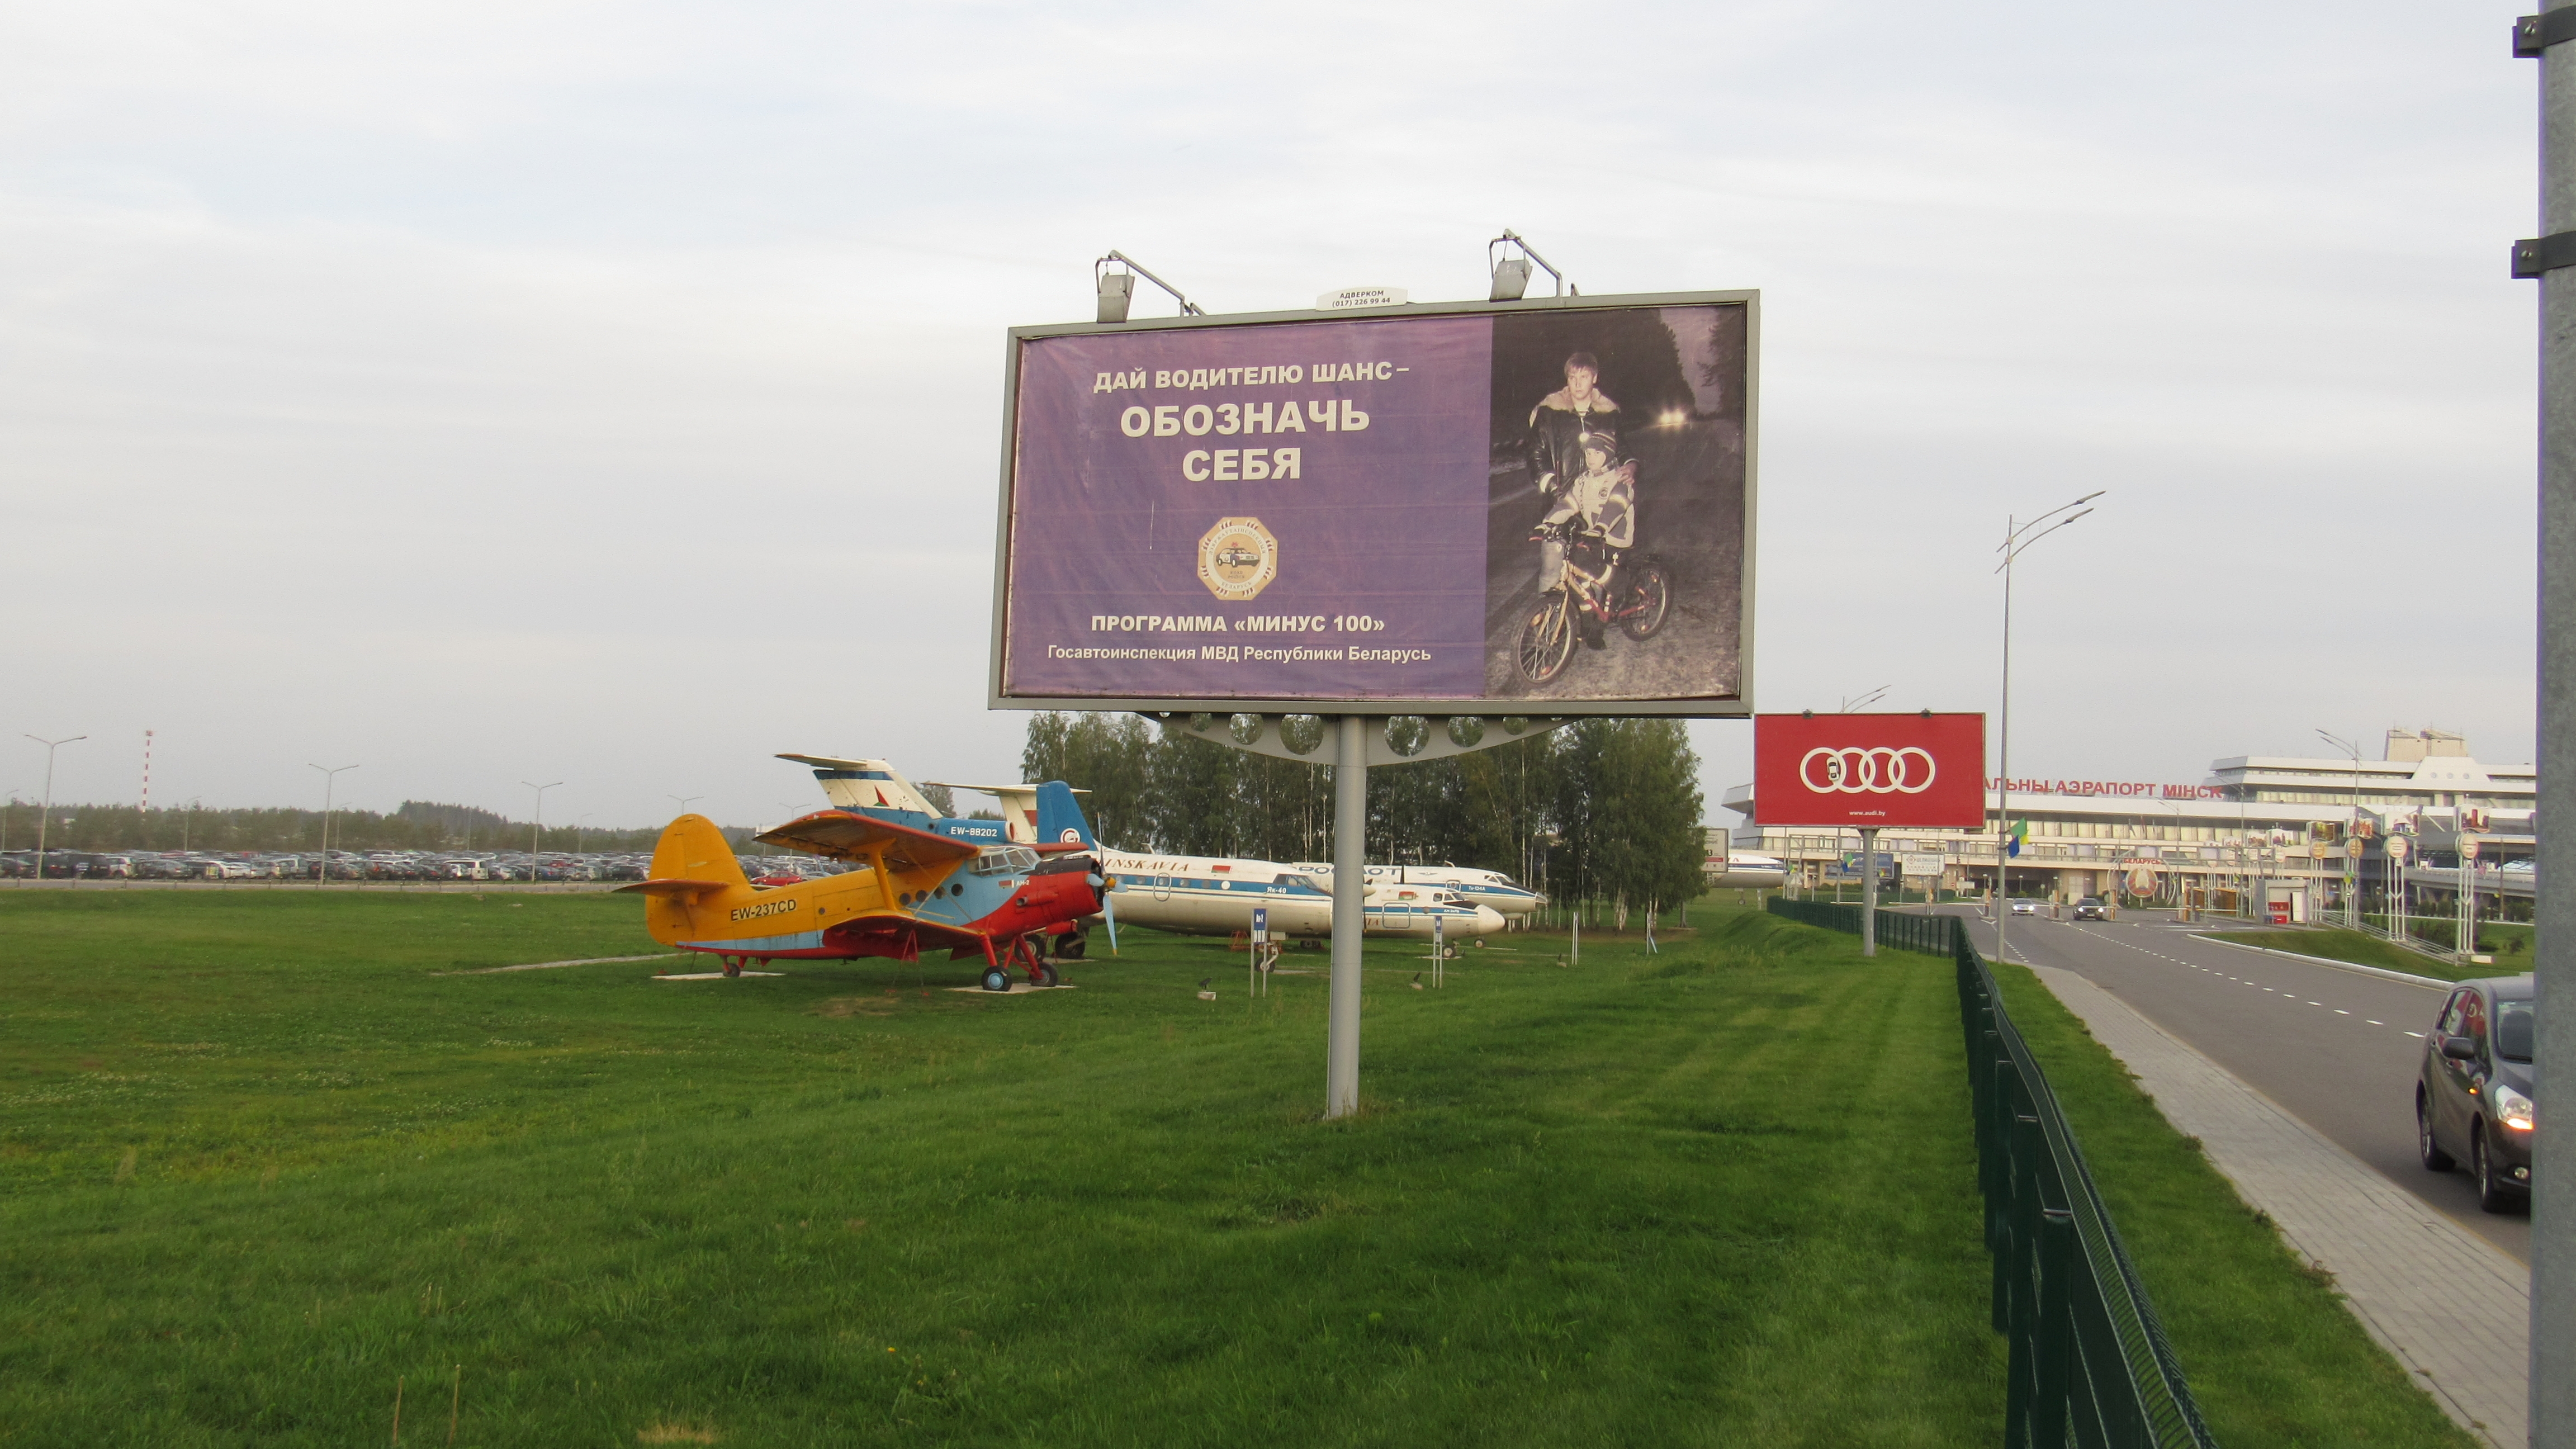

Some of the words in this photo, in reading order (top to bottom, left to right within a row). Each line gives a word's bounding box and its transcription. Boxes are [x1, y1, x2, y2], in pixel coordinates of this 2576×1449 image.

[1339, 290, 1384, 299] АДВЕРКОМ
[1332, 300, 1352, 308] (017)
[1093, 367, 1147, 394] ДАЙ
[1155, 364, 1303, 391] ВОДИТЕЛЮ
[1121, 399, 1370, 437] ОБОЗНАЧЬ
[1182, 447, 1301, 482] СЕБЯ
[1091, 615, 1228, 632] ПРОГРАММА
[1234, 615, 1325, 632] «МИНУС
[1333, 615, 1385, 632] 100»
[1048, 645, 1196, 662] Госавтоинспекция
[1201, 646, 1239, 662] МВД
[1244, 646, 1343, 664] Республики
[1348, 646, 1431, 664] Беларусь
[2054, 780, 2156, 797] АЭРАПОРТ
[2162, 784, 2223, 799] МІНСК
[951, 827, 997, 837] EW-88202
[1103, 859, 1190, 872] INSKAVIA
[1267, 886, 1287, 894] Як-40
[731, 899, 796, 921] EW-237CD
